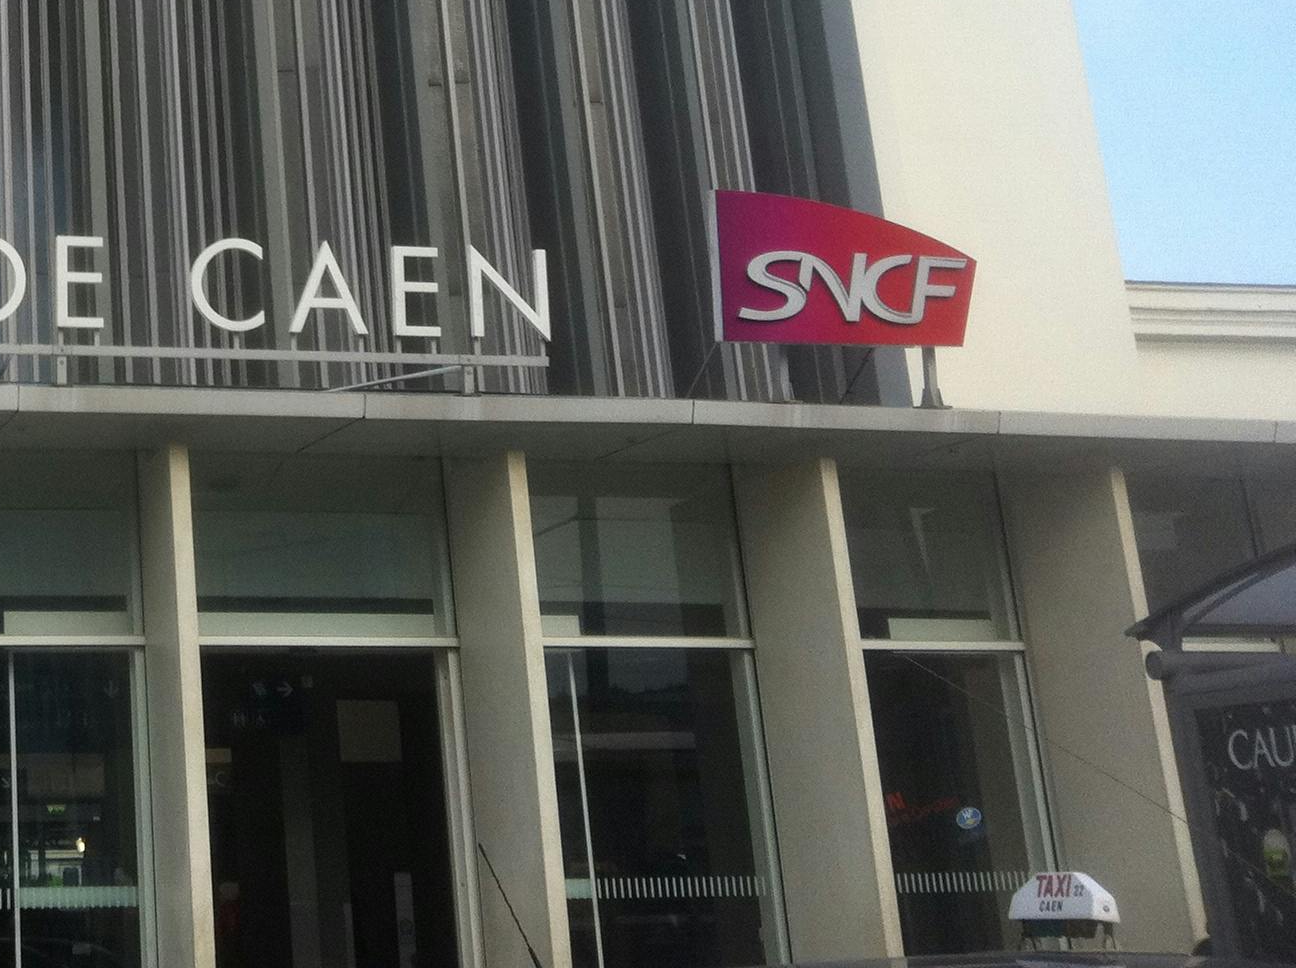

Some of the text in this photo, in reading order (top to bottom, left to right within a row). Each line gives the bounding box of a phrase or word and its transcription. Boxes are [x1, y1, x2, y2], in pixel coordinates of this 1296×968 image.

[191, 237, 551, 342] CAEN
[738, 250, 967, 325] SNCF
[1036, 874, 1072, 898] TAXI
[1039, 900, 1064, 912] CAEN
